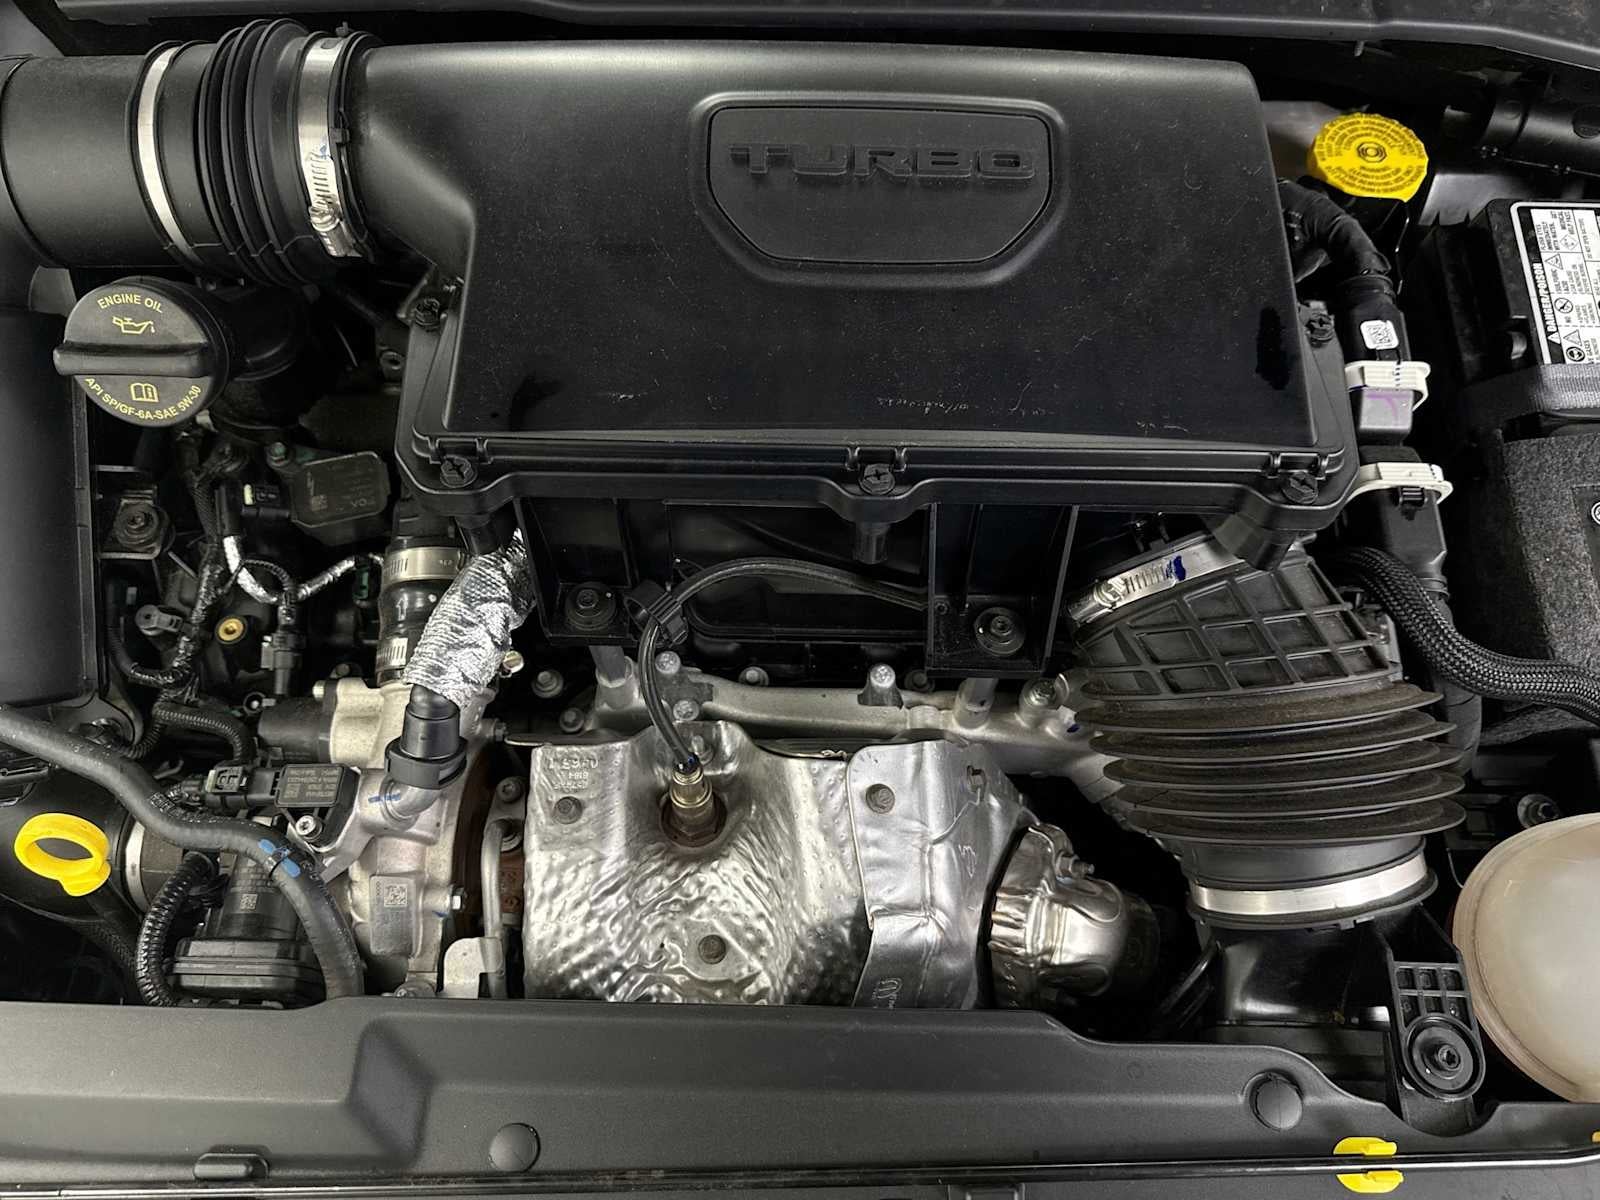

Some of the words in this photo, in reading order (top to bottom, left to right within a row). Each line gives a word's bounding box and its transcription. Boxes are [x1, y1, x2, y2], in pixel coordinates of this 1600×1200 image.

[728, 143, 1035, 179] TURBO
[97, 294, 142, 309] ENGINE
[144, 297, 163, 313] OIL
[1533, 263, 1557, 332] DANGER/POISON
[85, 377, 104, 396] API
[177, 385, 202, 412] 5W-30
